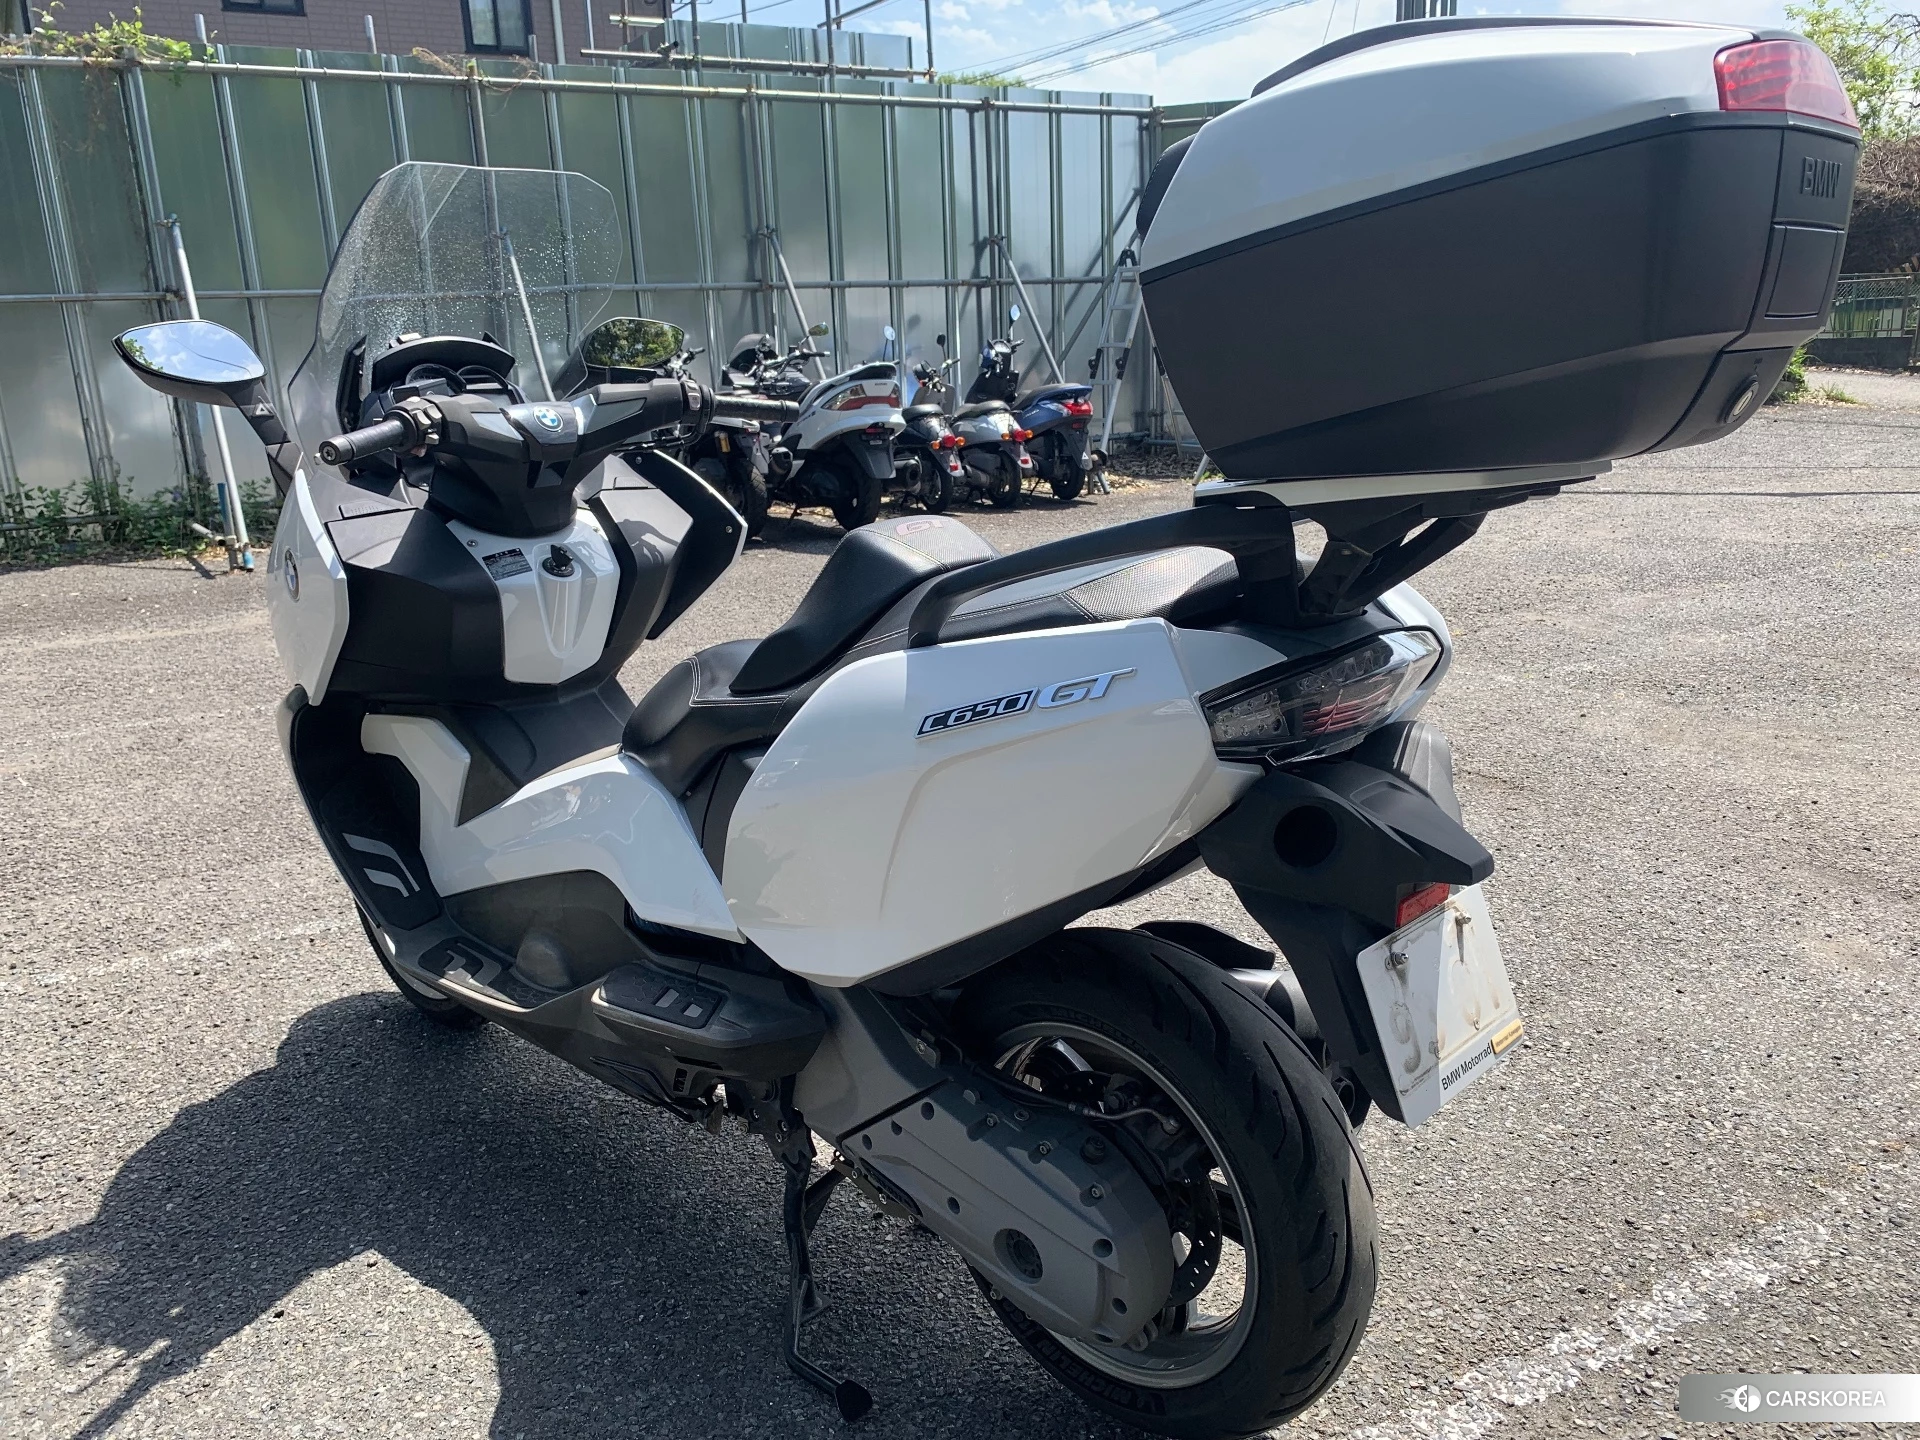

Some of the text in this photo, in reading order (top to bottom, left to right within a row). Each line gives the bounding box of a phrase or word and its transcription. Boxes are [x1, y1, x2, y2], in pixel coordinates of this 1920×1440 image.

[1800, 156, 1842, 198] BMW
[1037, 667, 1137, 709] GT
[1441, 1067, 1461, 1091] BMW
[1461, 1043, 1492, 1075] Motorrad
[1036, 1340, 1132, 1405] MICHELIN
